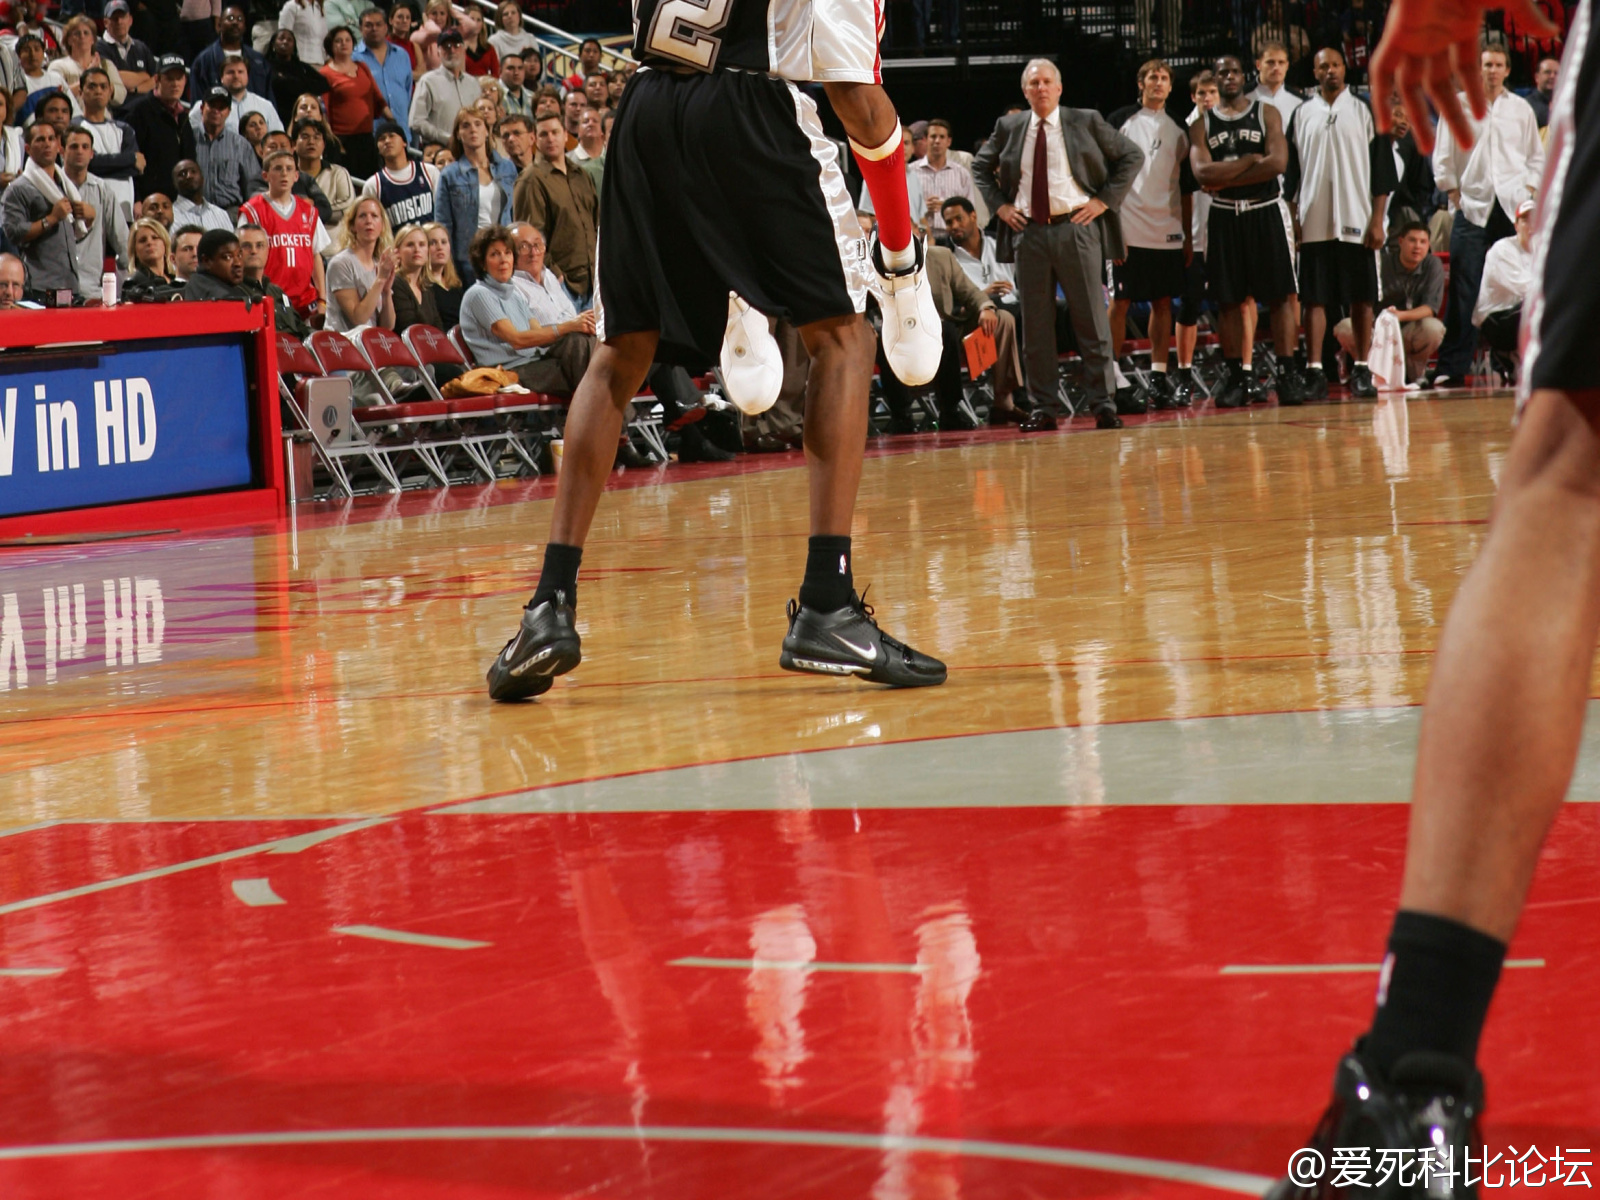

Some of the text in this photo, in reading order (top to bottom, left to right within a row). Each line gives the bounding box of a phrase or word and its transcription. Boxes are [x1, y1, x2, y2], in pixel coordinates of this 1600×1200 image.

[286, 247, 296, 268] 11
[34, 384, 80, 472] in
[94, 377, 157, 466] HD
